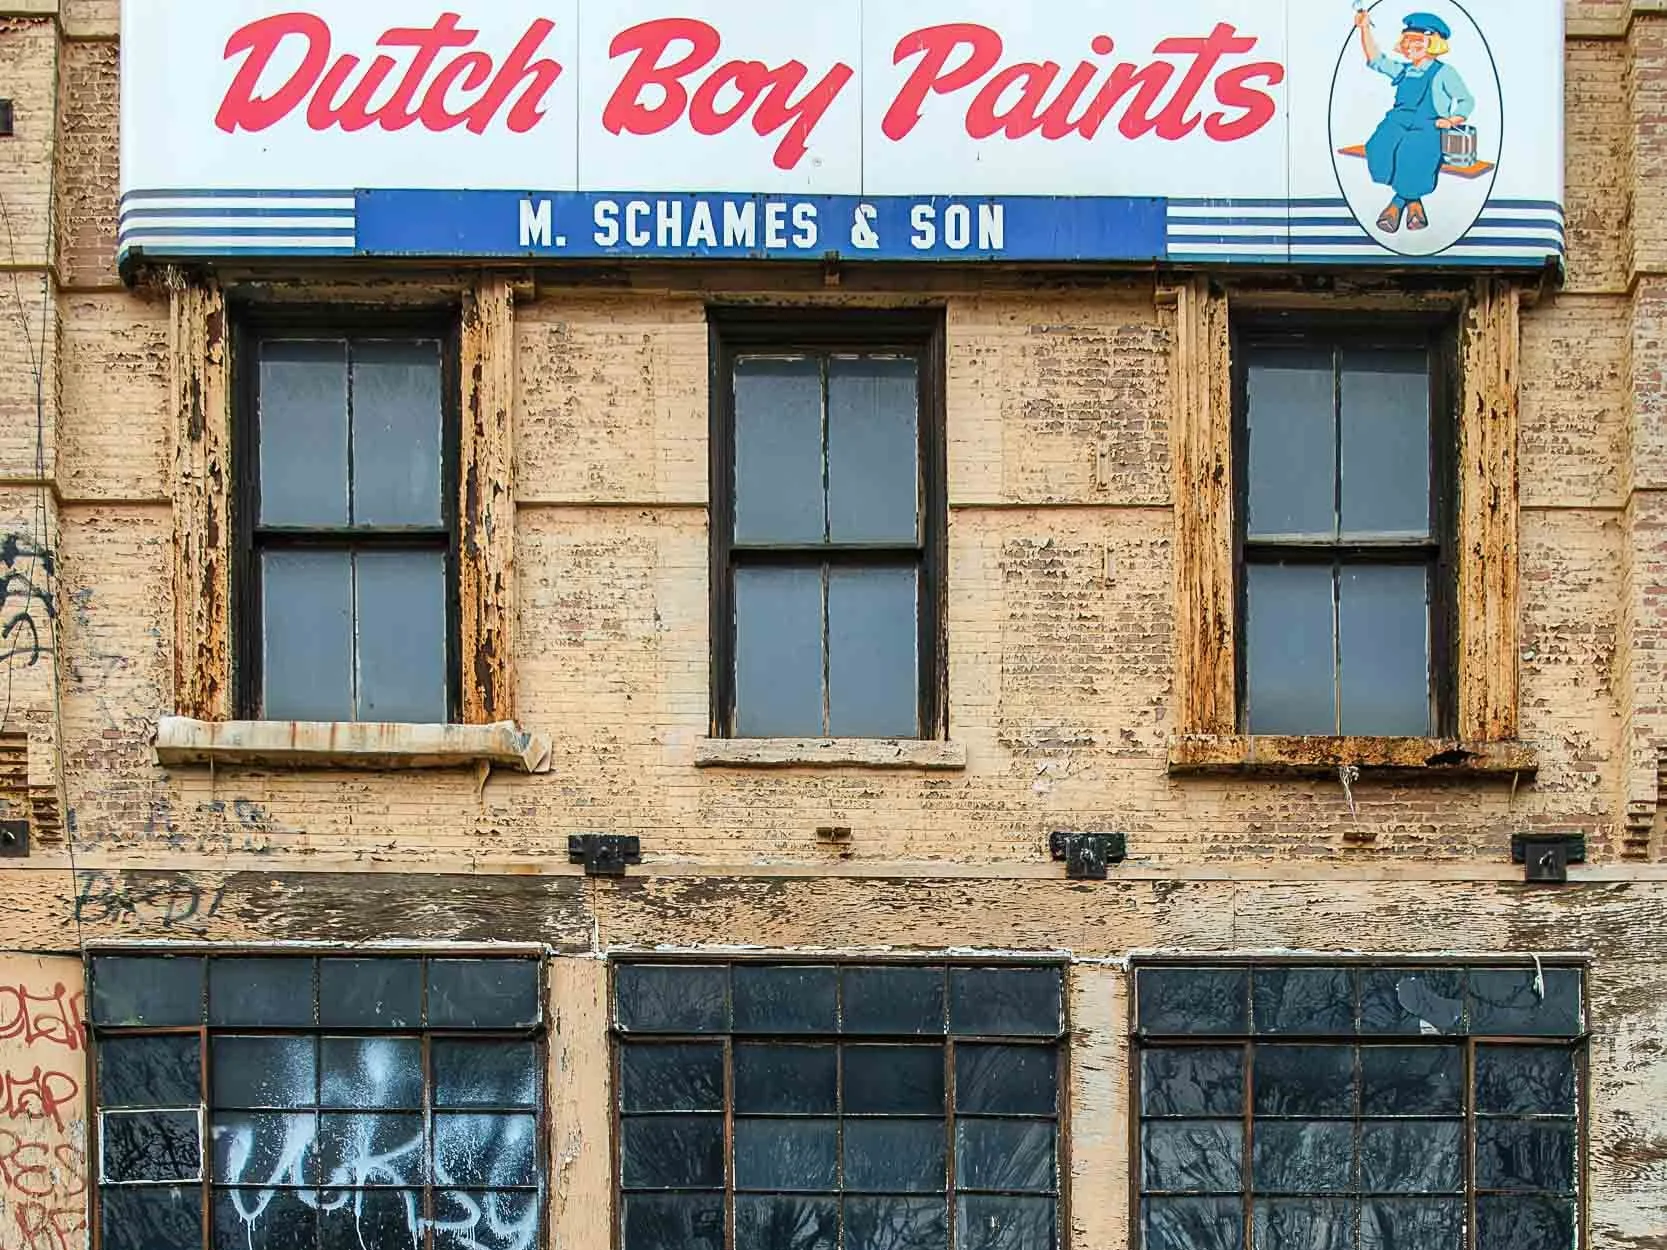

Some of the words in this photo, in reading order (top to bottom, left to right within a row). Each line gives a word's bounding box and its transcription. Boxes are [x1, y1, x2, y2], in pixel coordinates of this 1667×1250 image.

[214, 12, 562, 135] Dutch
[602, 17, 853, 170] Boy
[881, 22, 1284, 142] Paints
[519, 200, 567, 248] M.
[594, 201, 817, 249] SCHAMES
[851, 205, 880, 249] &
[911, 204, 1004, 250] SON
